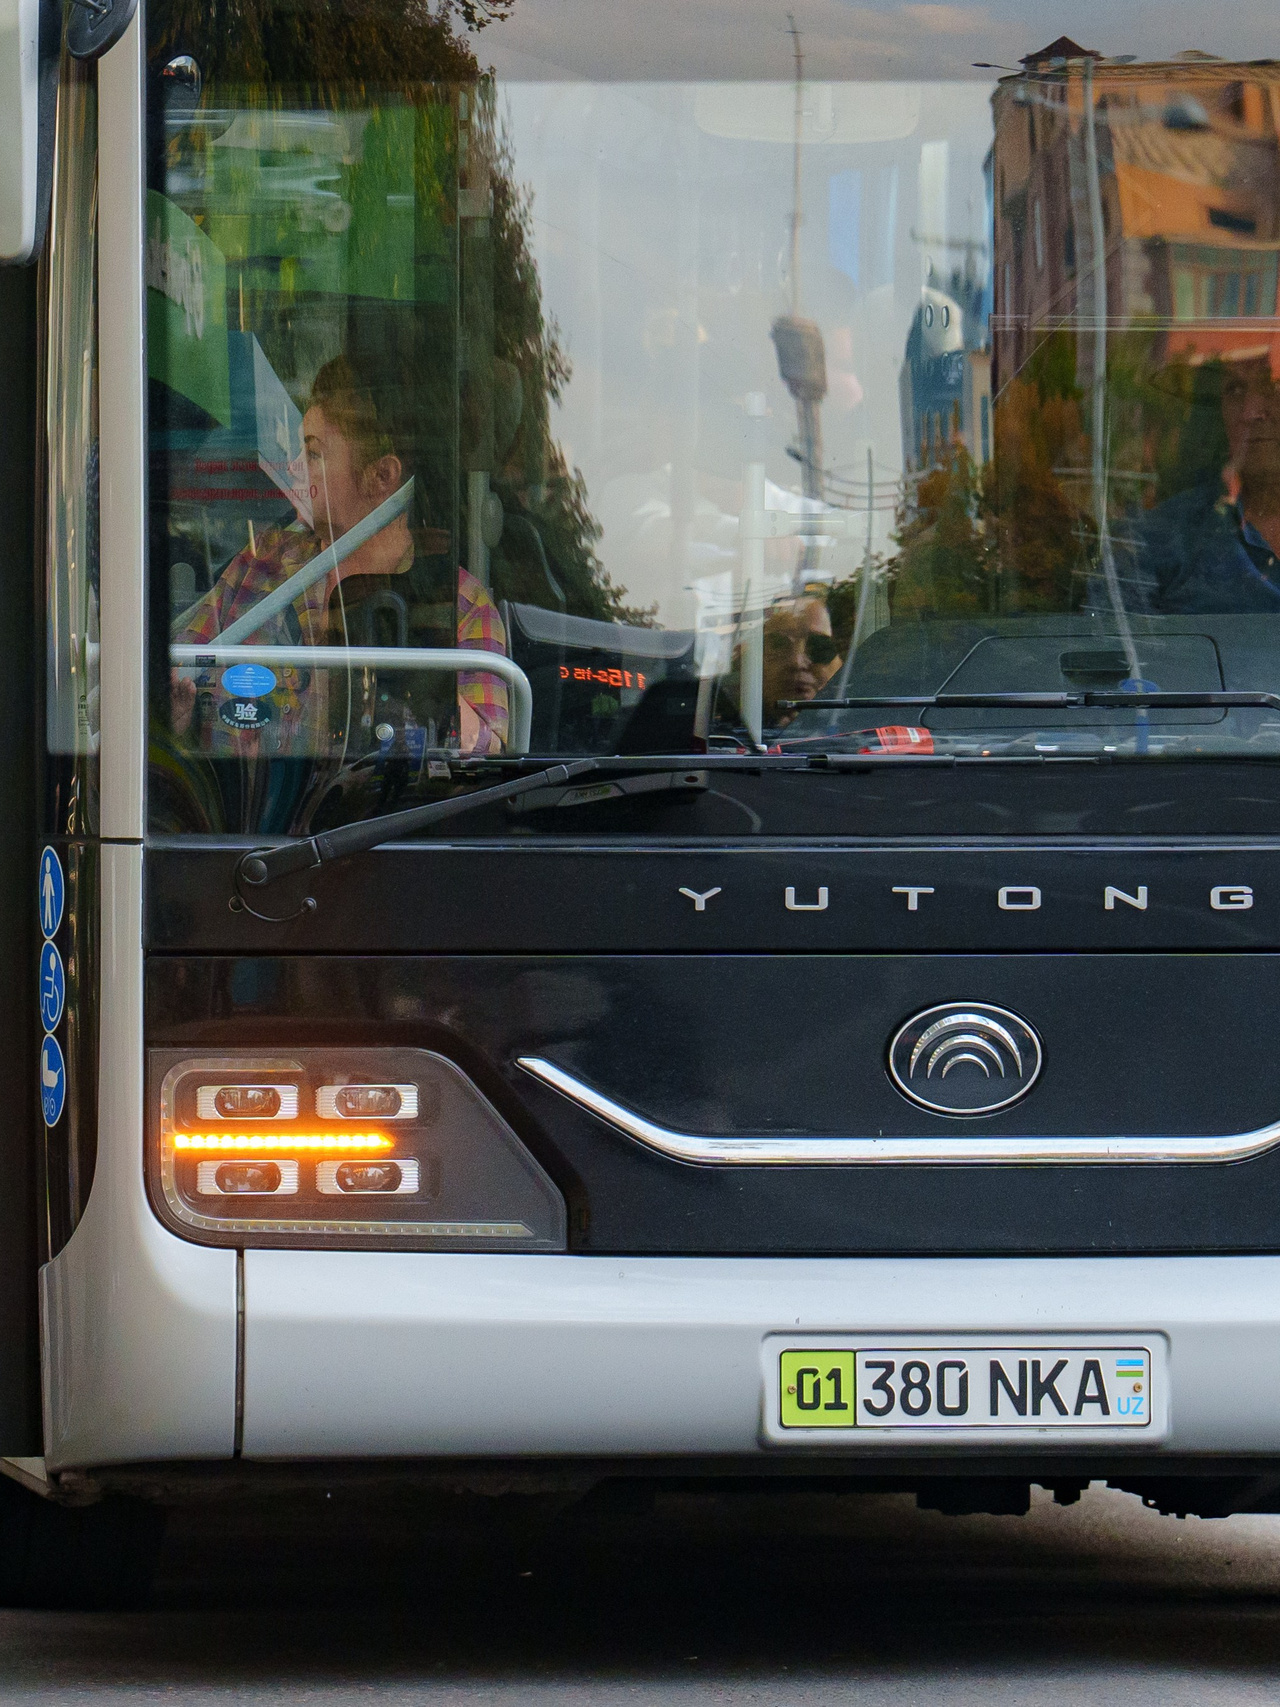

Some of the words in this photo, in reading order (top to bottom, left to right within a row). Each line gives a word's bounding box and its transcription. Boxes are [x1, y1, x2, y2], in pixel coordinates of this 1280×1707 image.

[234, 702, 259, 721] 验
[678, 885, 1254, 911] YUTONG
[796, 1368, 848, 1410] 01
[863, 1360, 969, 1417] 380
[990, 1359, 1111, 1416] NKA
[1117, 1397, 1144, 1415] UZ
